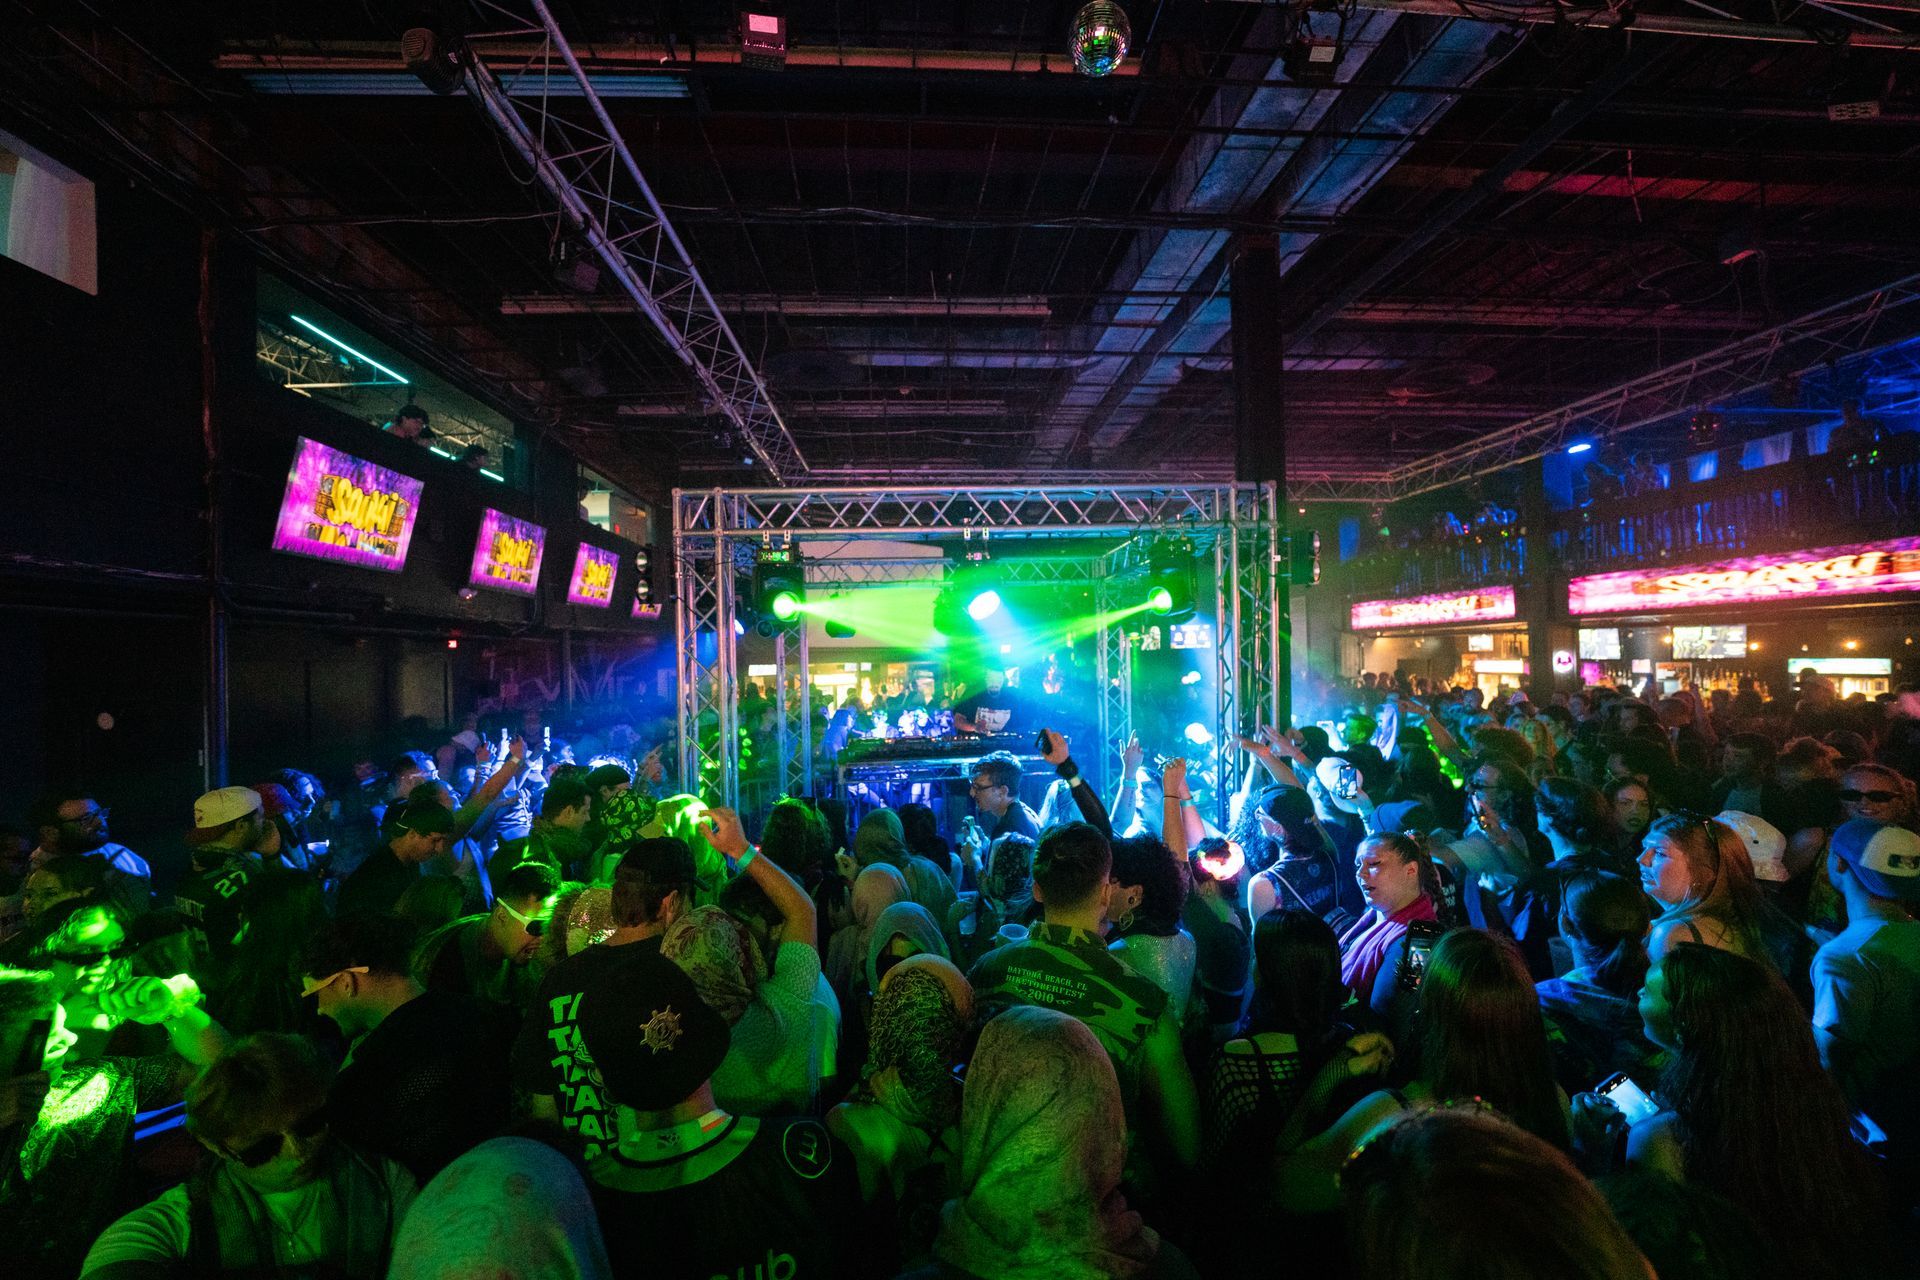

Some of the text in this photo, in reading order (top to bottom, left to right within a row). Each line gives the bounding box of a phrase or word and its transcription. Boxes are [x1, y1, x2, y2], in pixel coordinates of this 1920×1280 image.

[214, 870, 249, 899] 27
[1005, 975, 1086, 998] BIKETOBERFEST
[1008, 966, 1088, 991] DAYTONA BEACH, FL
[1028, 989, 1055, 1003] 2010
